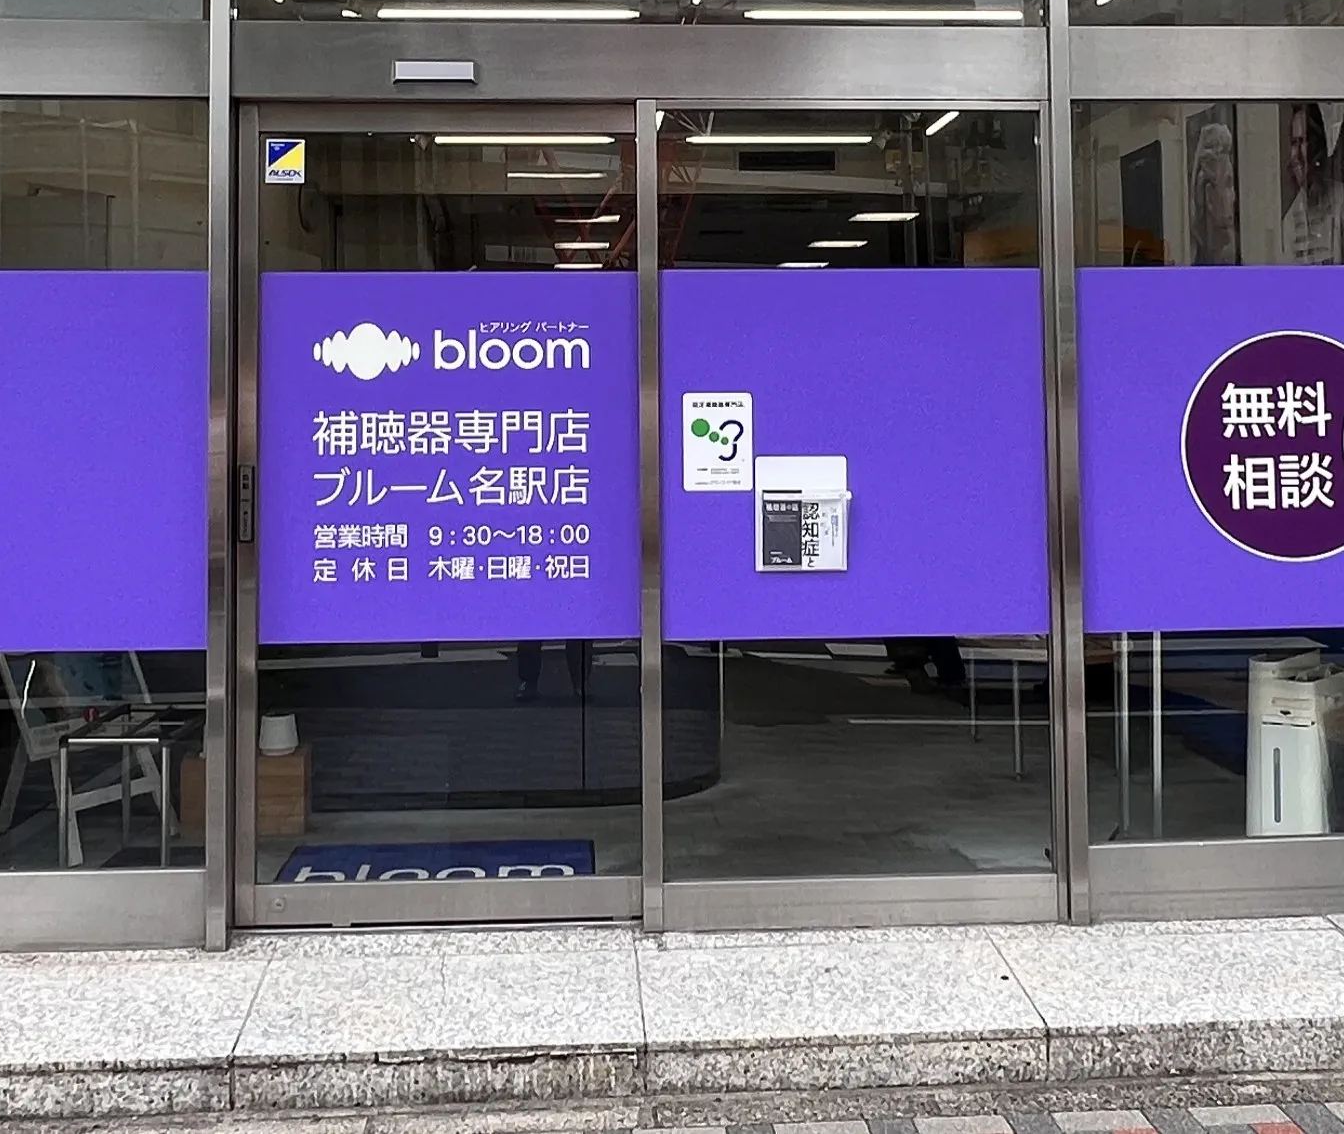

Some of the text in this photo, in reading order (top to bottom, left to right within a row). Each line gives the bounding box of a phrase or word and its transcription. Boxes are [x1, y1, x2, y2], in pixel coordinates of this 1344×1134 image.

[433, 329, 591, 371] bloom
[312, 407, 590, 457] 補聴器専門店
[1220, 380, 1333, 439] 無料
[313, 464, 590, 507] ブルーム名駅店
[1223, 452, 1336, 511] 相談
[313, 523, 409, 549] 営業時間
